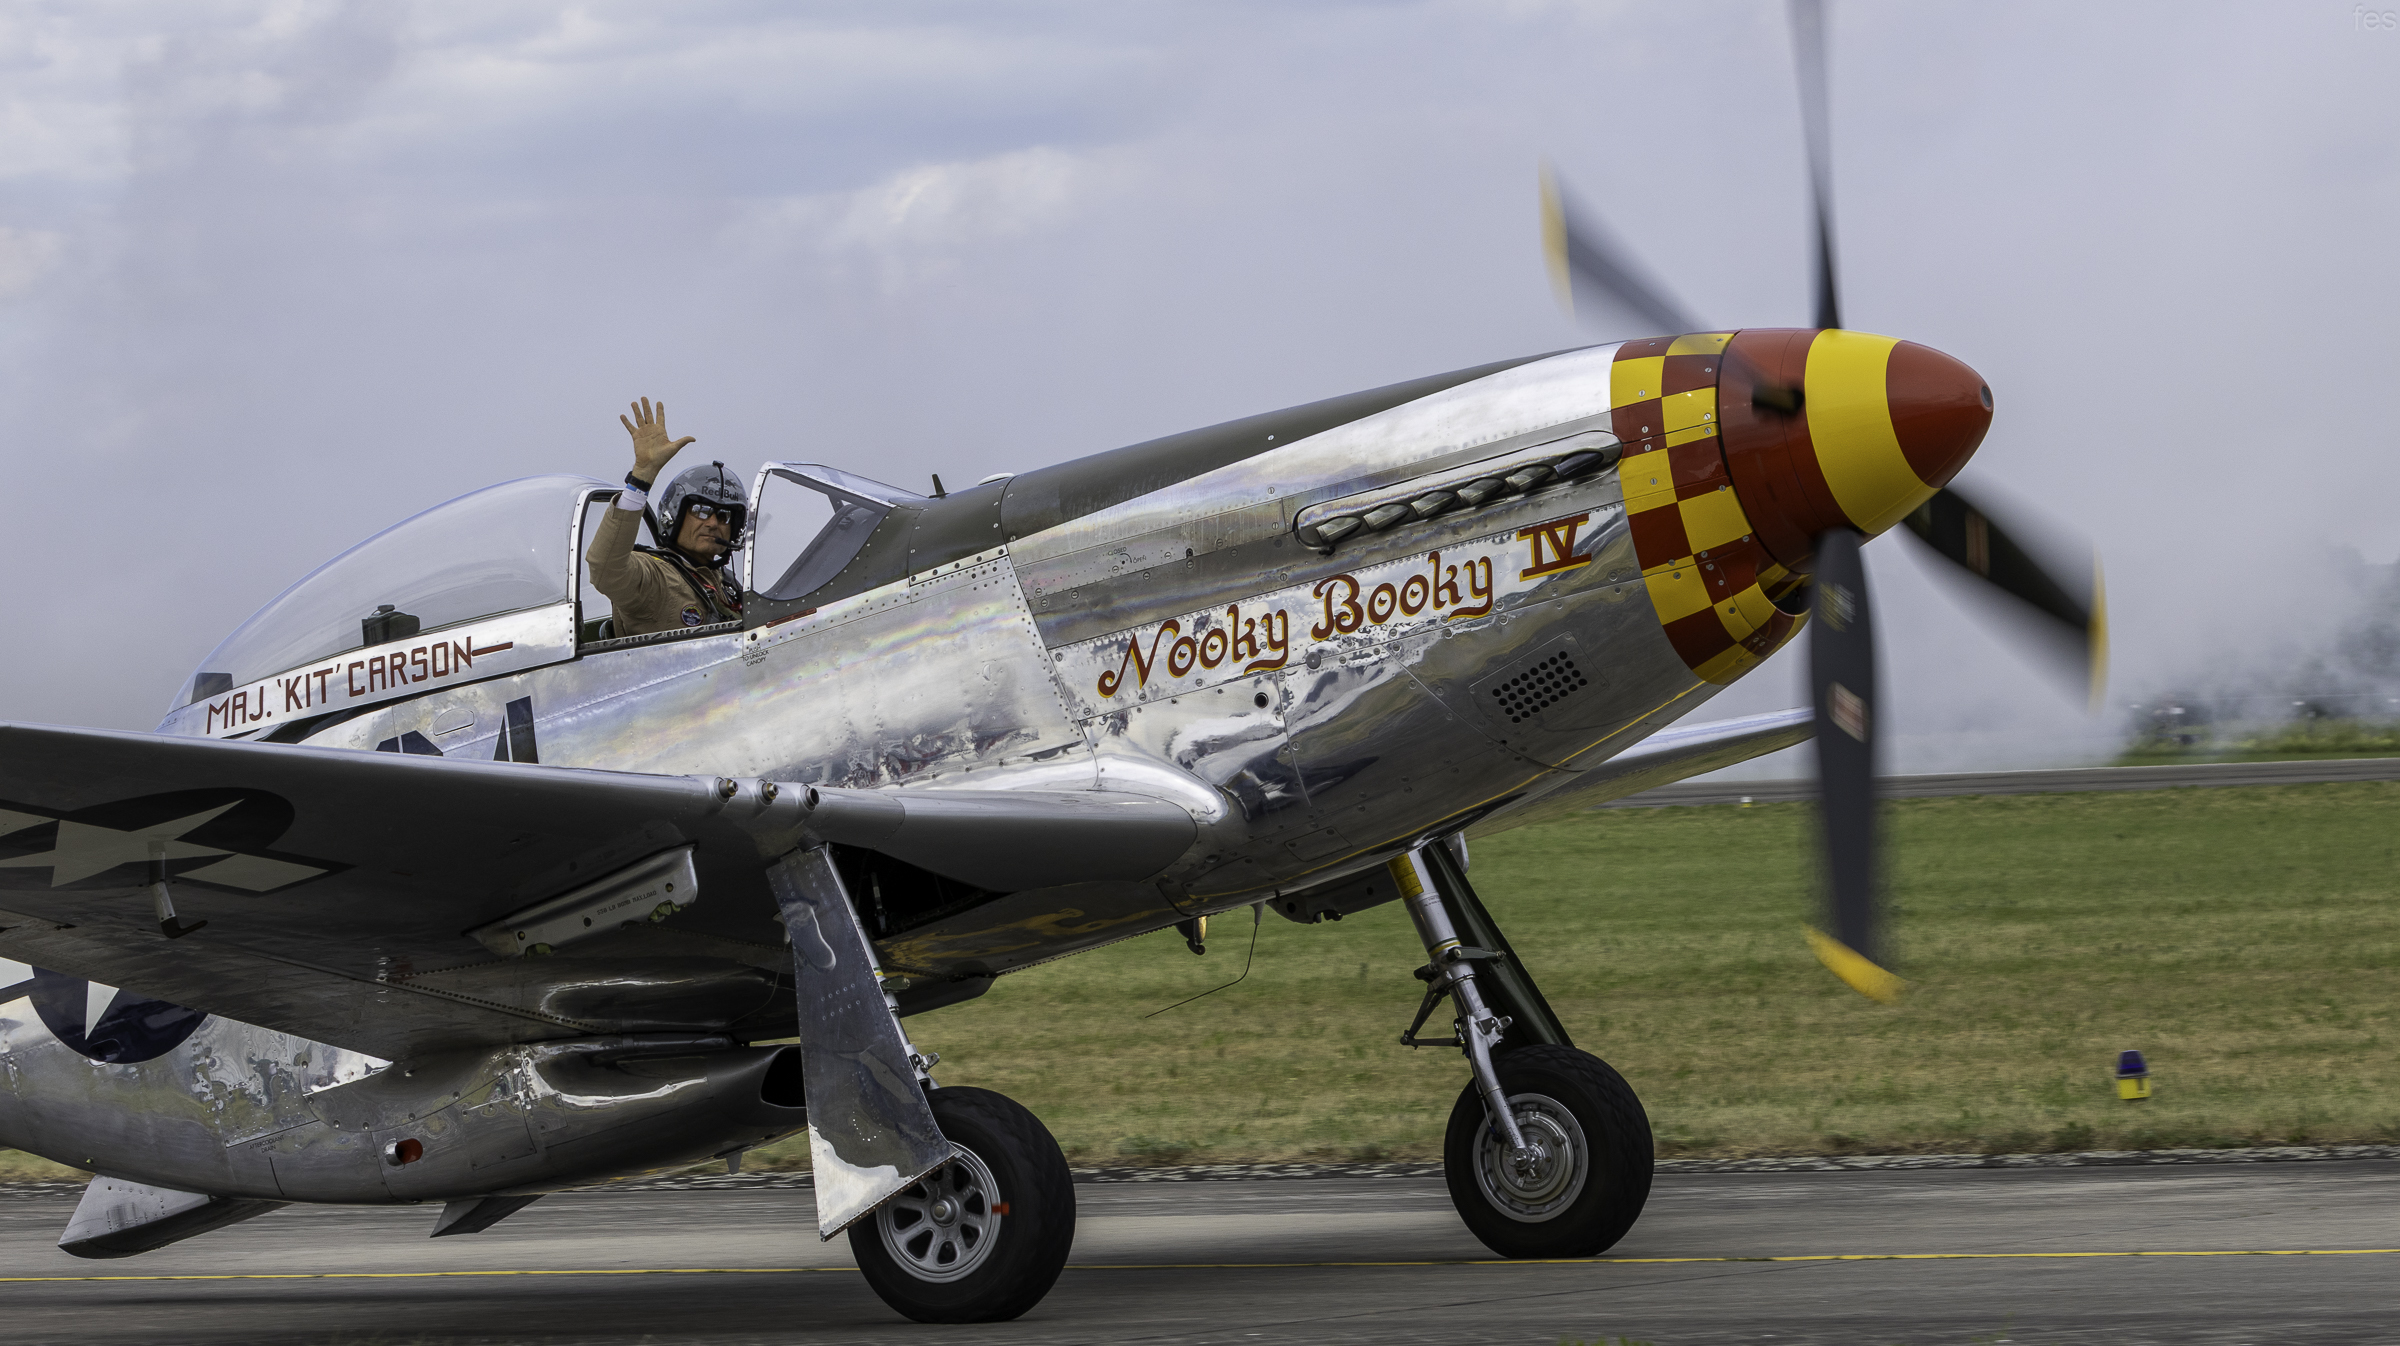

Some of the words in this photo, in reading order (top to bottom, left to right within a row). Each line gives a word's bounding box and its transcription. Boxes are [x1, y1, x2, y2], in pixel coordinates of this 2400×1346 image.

[701, 486, 720, 497] Red
[724, 489, 739, 502] Bull
[1097, 604, 1289, 698] Nooky
[1311, 551, 1493, 641] Booky
[1516, 513, 1592, 582] IV
[746, 656, 767, 667] CANOPY
[206, 685, 272, 735] MAJ.
